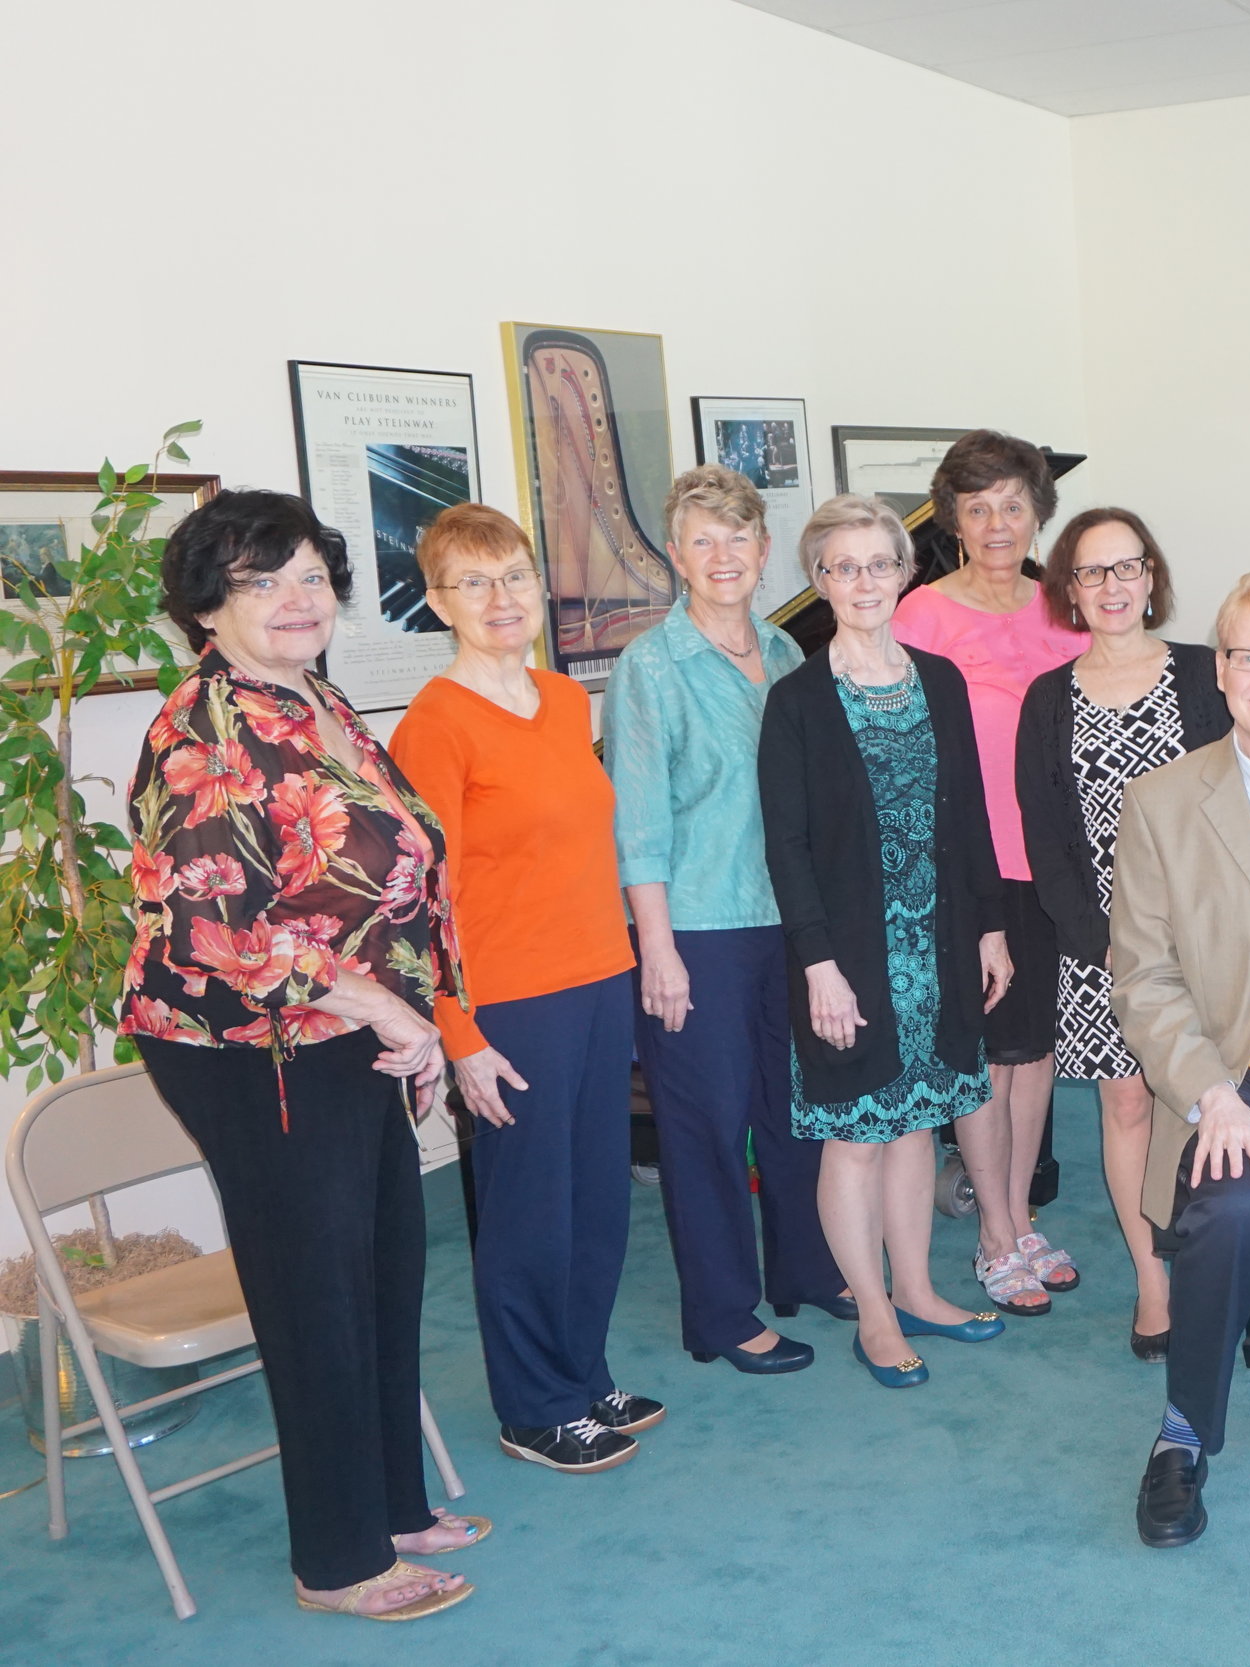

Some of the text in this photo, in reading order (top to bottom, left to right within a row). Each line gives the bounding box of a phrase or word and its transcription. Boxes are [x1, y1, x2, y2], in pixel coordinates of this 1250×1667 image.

[317, 390, 457, 408] VAN CLIBURN WINNERS
[344, 416, 435, 429] PLAY STEINWAY
[376, 529, 415, 555] STEINW
